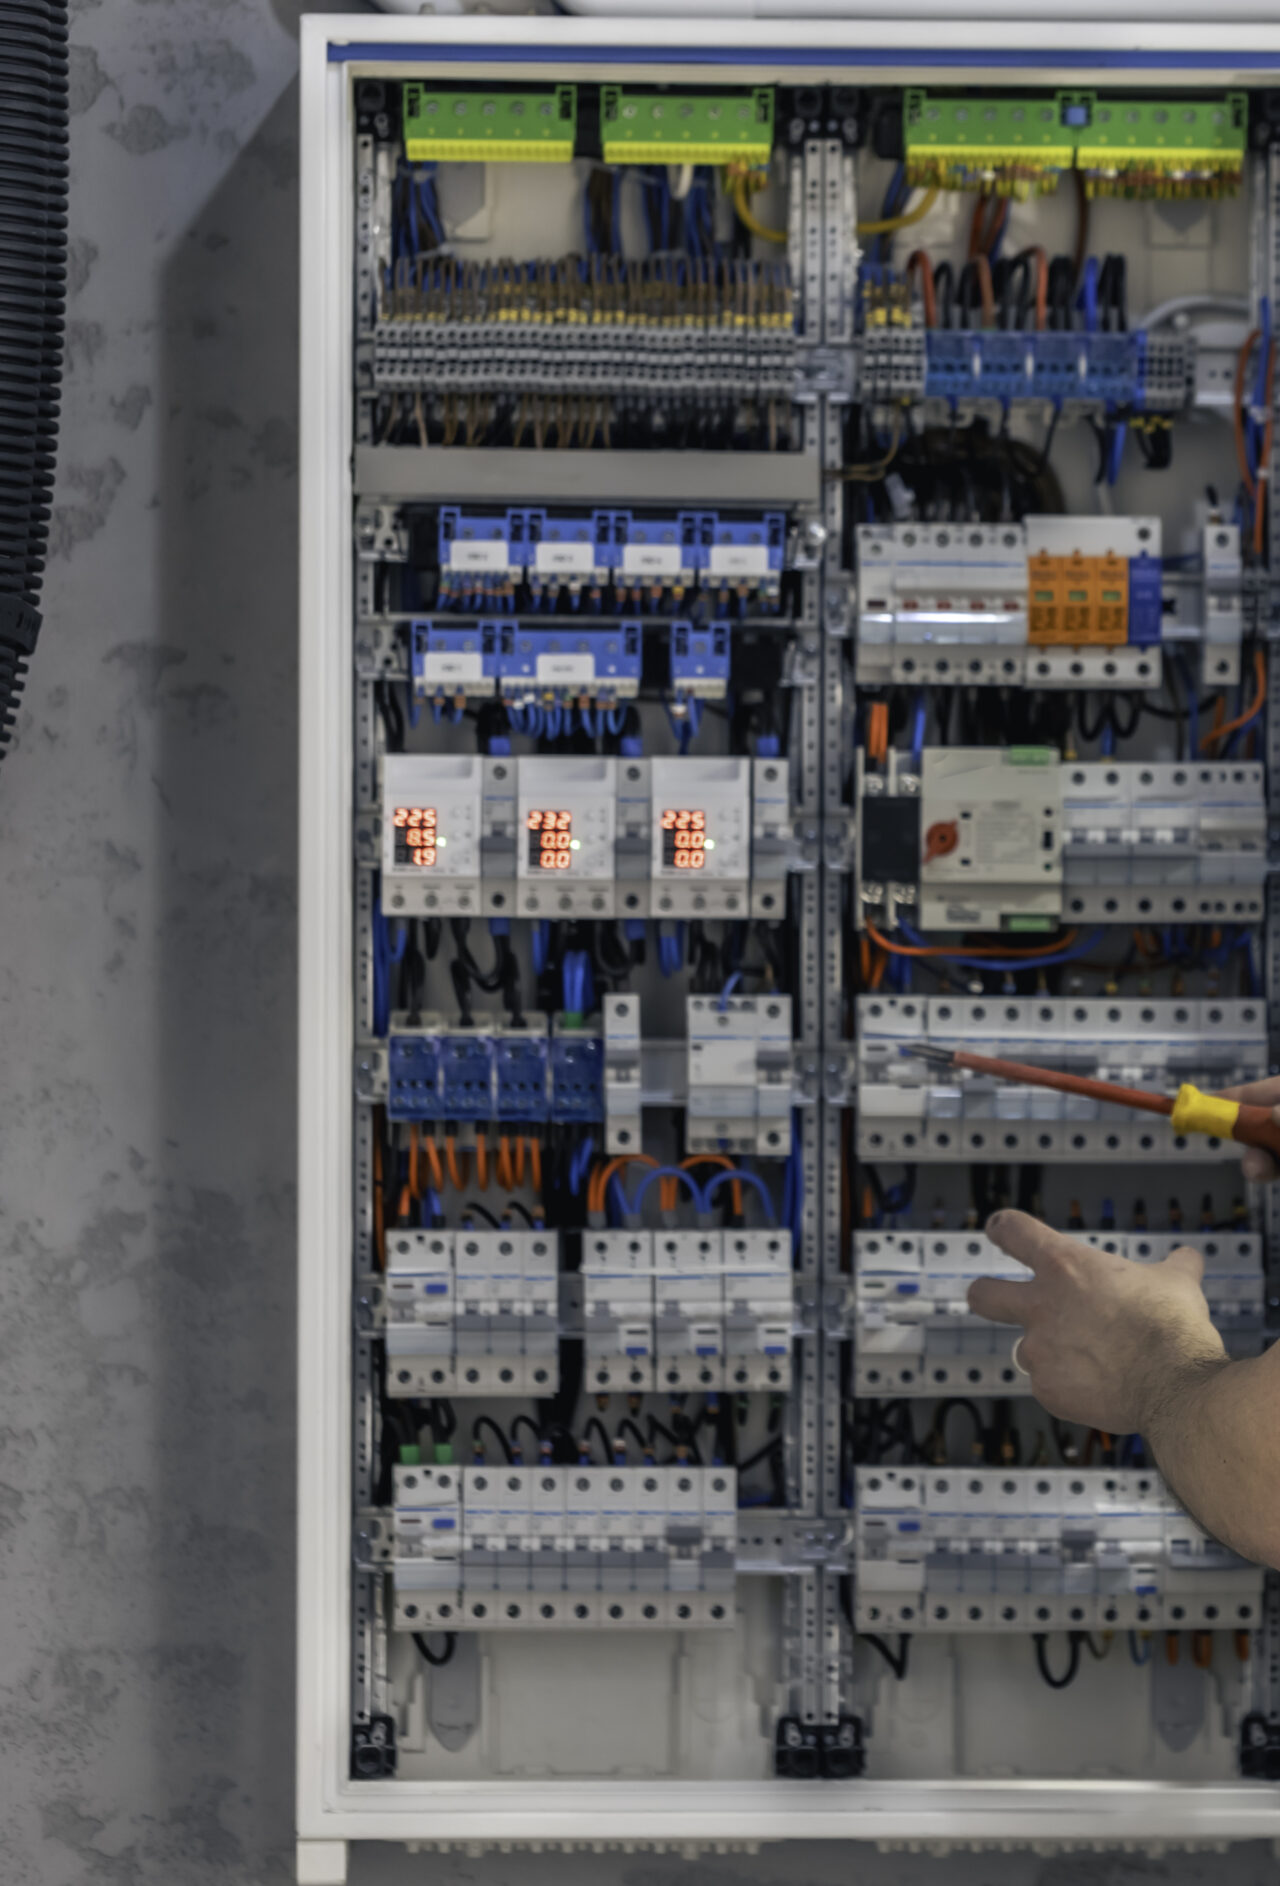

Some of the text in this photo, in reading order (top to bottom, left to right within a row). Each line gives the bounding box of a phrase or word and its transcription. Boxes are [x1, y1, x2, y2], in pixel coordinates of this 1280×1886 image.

[393, 808, 437, 828] 225
[527, 810, 572, 830] 232
[661, 809, 705, 829] 225
